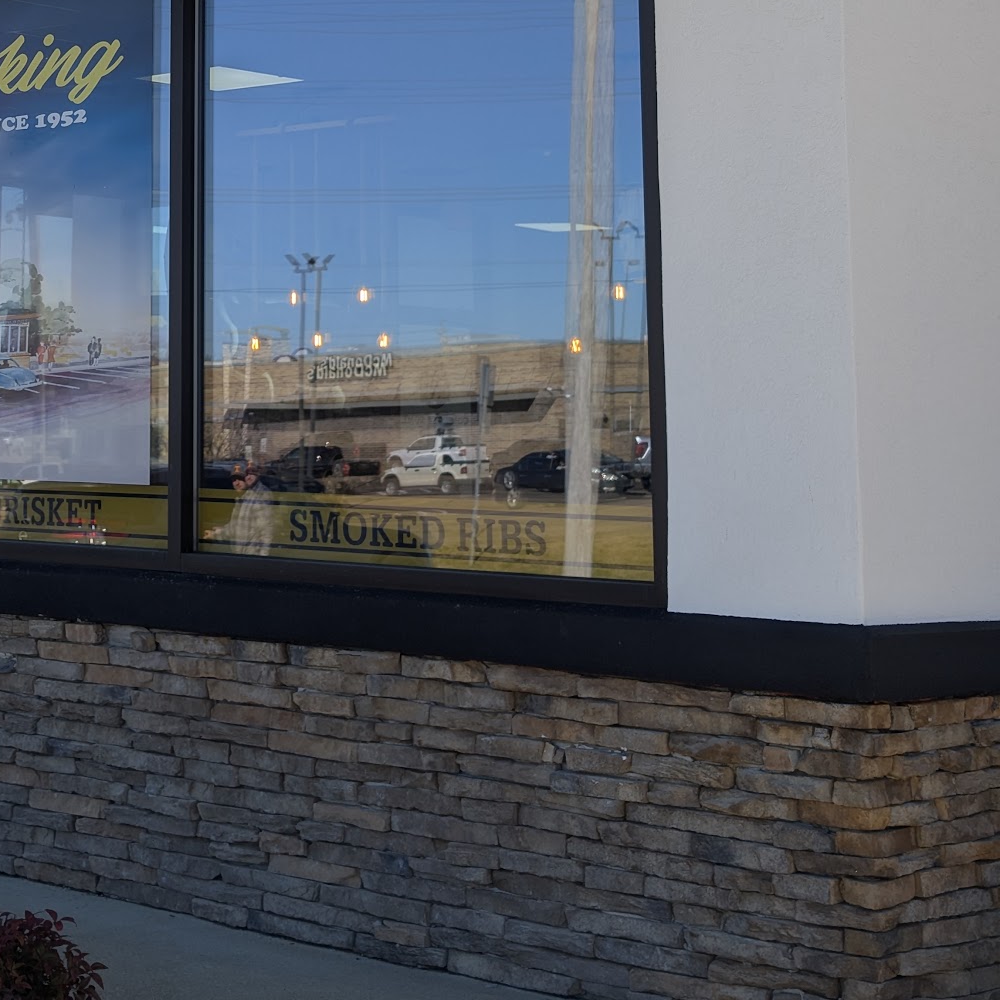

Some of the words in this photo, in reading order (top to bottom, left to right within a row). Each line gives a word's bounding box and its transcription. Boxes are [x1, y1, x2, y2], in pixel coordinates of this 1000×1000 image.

[34, 109, 88, 130] 1952
[289, 508, 446, 549] SMOKED
[456, 516, 546, 557] RIBS
